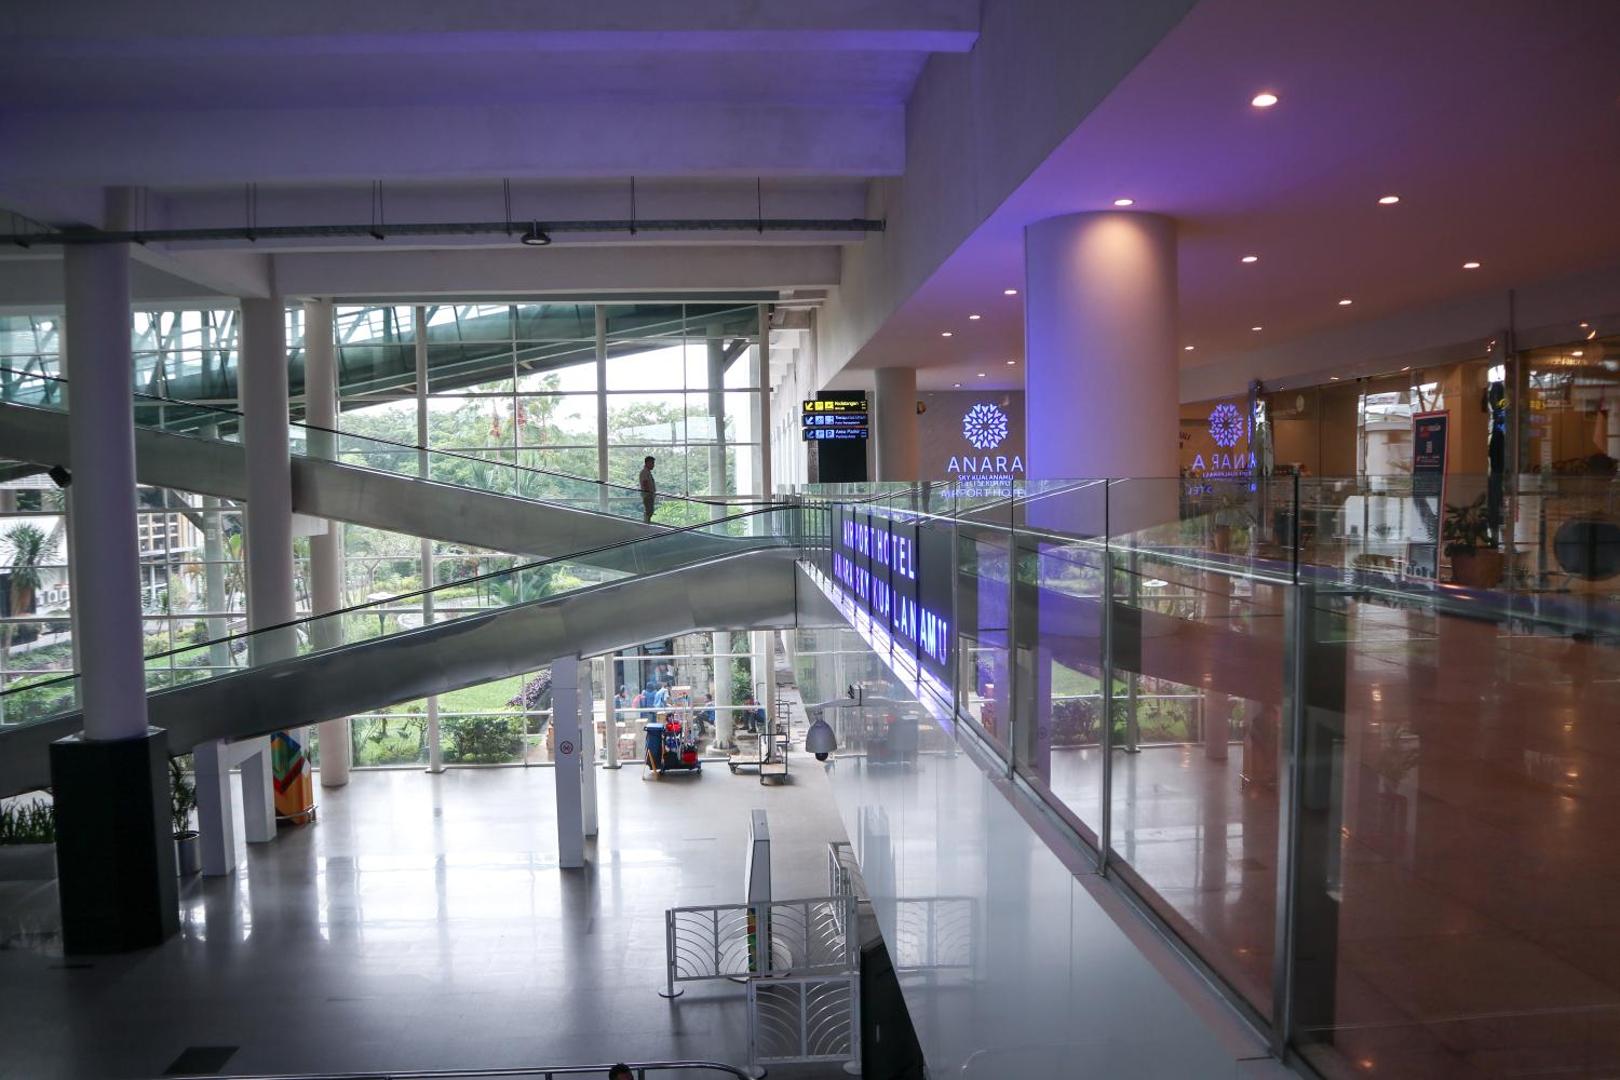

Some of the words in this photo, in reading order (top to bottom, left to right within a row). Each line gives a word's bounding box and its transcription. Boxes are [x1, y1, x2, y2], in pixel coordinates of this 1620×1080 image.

[947, 455, 1024, 473] ANARA
[843, 519, 875, 560] AIRPORT
[876, 528, 915, 580] HOTEL
[855, 565, 870, 602] SKY
[872, 576, 948, 666] KUALANAMU
